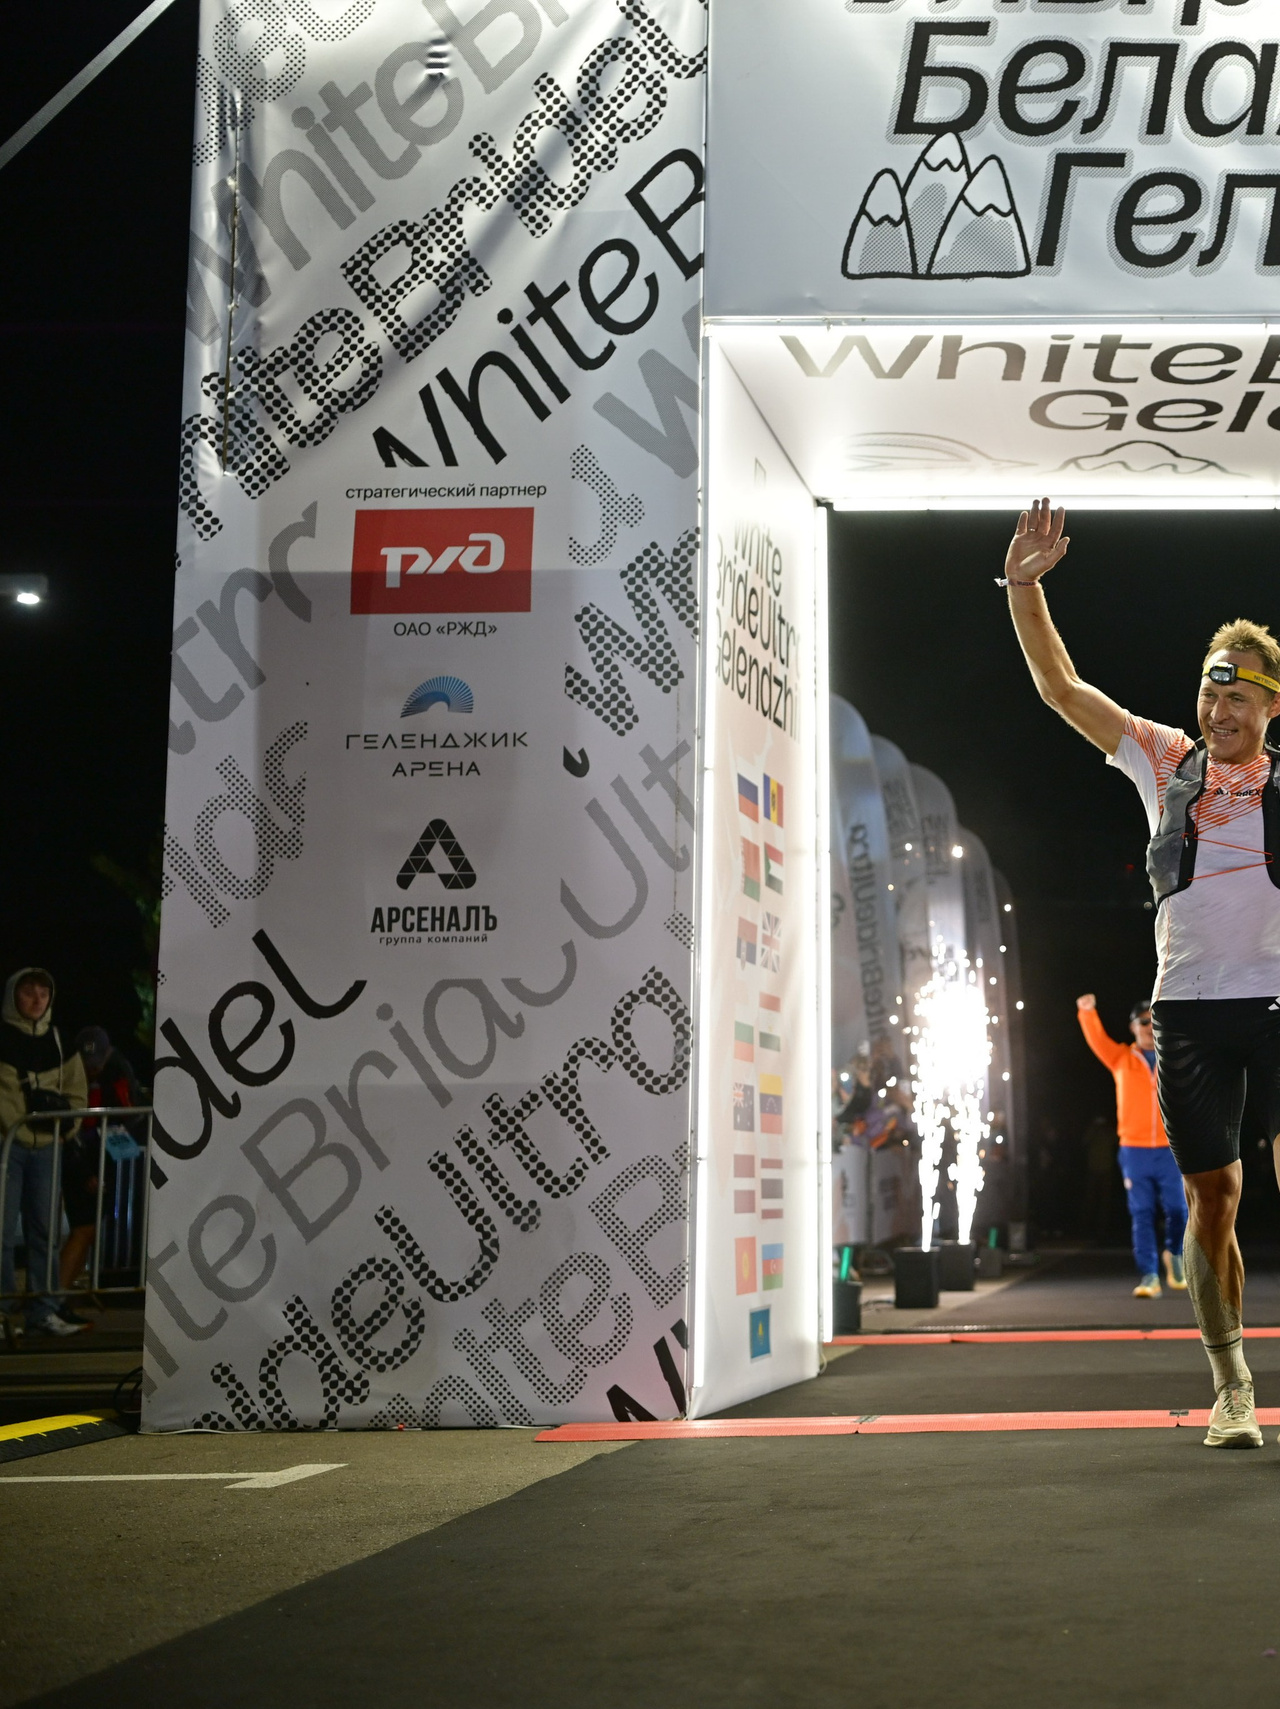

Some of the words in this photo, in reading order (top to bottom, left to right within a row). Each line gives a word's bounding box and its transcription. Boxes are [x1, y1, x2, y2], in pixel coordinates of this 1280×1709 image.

[345, 483, 476, 501] стратегический
[480, 484, 547, 499] партнер
[394, 622, 431, 636] ОАО
[436, 621, 498, 637] «РЖД»
[346, 731, 528, 750] ГЕЛЕНДЖИК
[391, 761, 481, 777] АРЕНА
[370, 905, 498, 933] АРСЕНАЛЪ
[379, 935, 422, 946] группа
[427, 934, 488, 944] компаний
